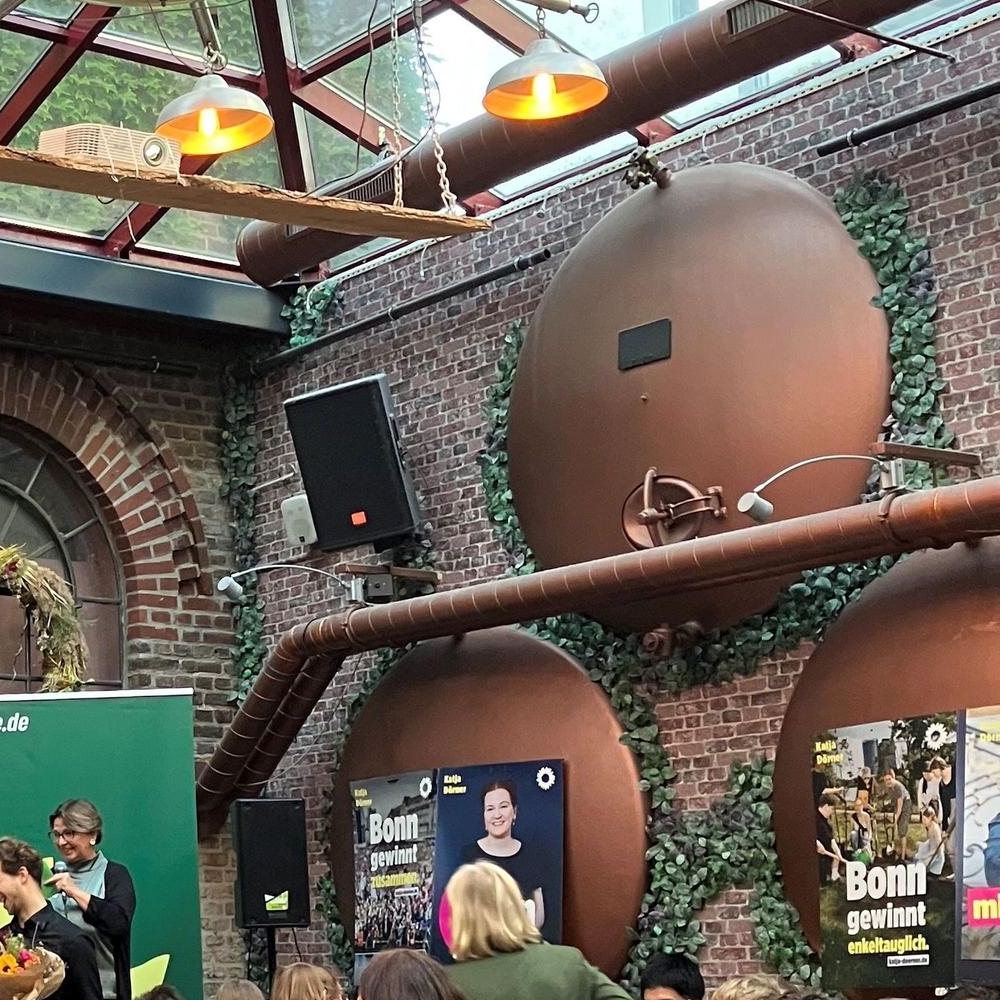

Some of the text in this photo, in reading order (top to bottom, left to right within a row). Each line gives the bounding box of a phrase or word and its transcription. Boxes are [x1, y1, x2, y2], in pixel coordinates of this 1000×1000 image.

[369, 813, 418, 845] Bonn
[370, 844, 418, 872] gewinnt
[846, 861, 927, 901] Bonn
[847, 901, 926, 935] gewinnt
[848, 934, 930, 955] enkeltauglich.
